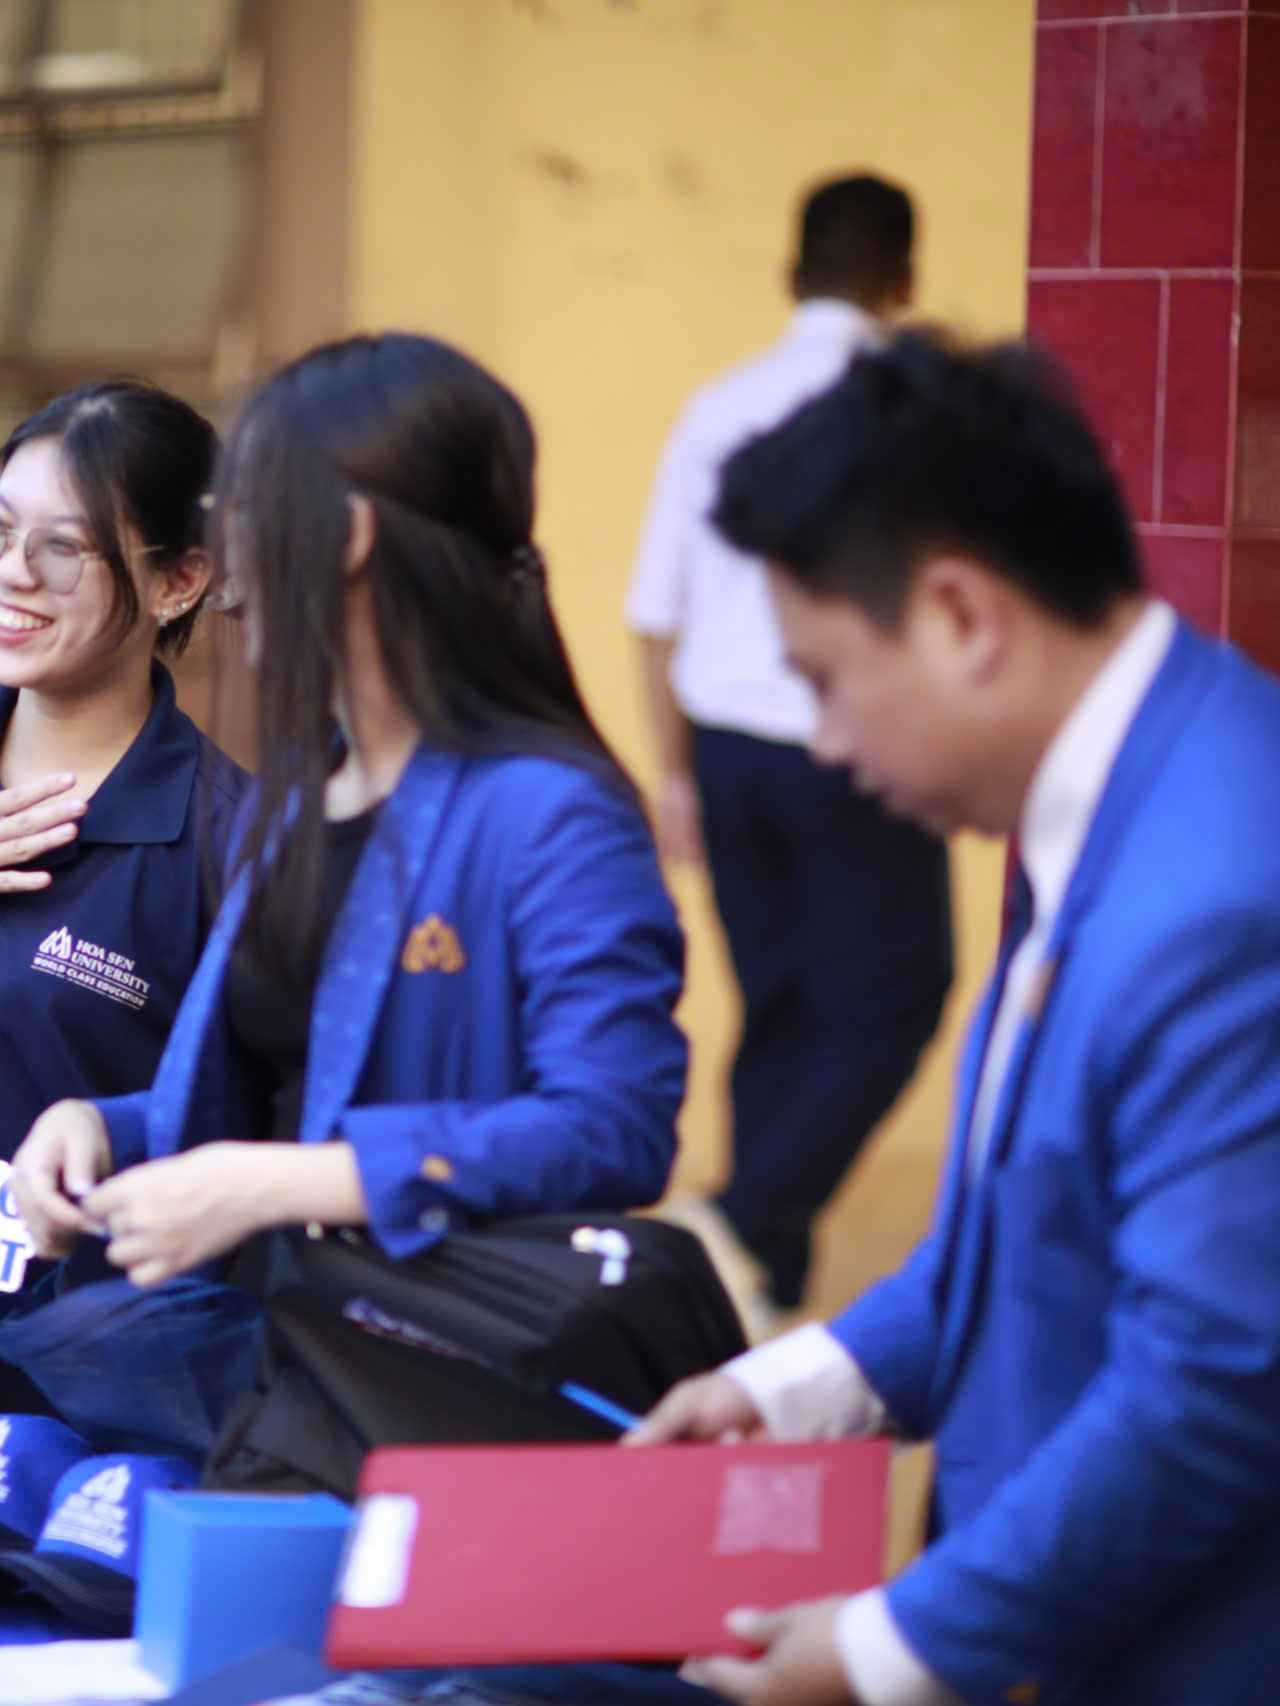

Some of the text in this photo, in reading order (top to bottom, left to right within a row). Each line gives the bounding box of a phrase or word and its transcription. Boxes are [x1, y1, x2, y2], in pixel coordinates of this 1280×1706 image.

[71, 951, 150, 993] UNIVERSITY
[76, 939, 135, 971] HOA SEN
[33, 957, 145, 1006] WORLD CLASS EDUCATION
